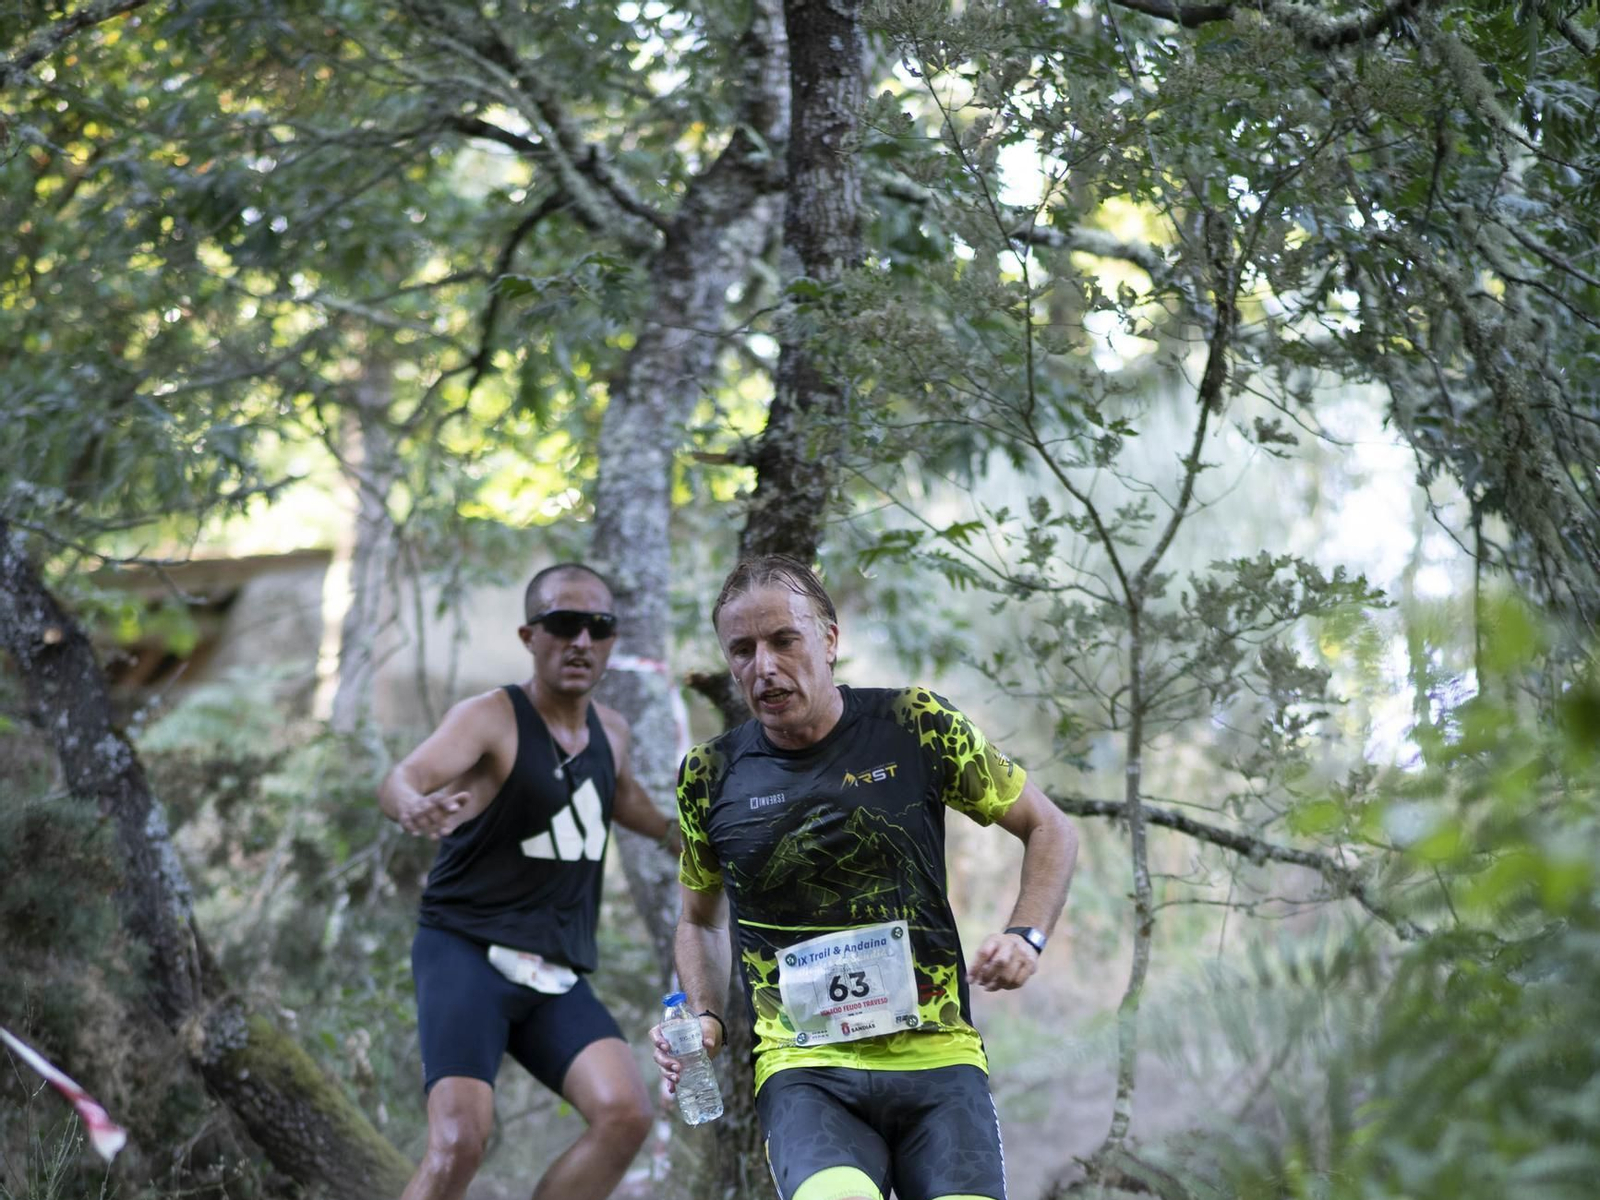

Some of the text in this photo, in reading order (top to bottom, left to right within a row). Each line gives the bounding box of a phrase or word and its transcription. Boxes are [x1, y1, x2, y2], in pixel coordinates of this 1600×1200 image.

[797, 957, 808, 968] IX
[809, 947, 831, 963] Trail
[833, 945, 841, 956] &
[844, 937, 887, 954] Andaina
[829, 971, 870, 1002] 63
[863, 997, 888, 1008] TRAVESO
